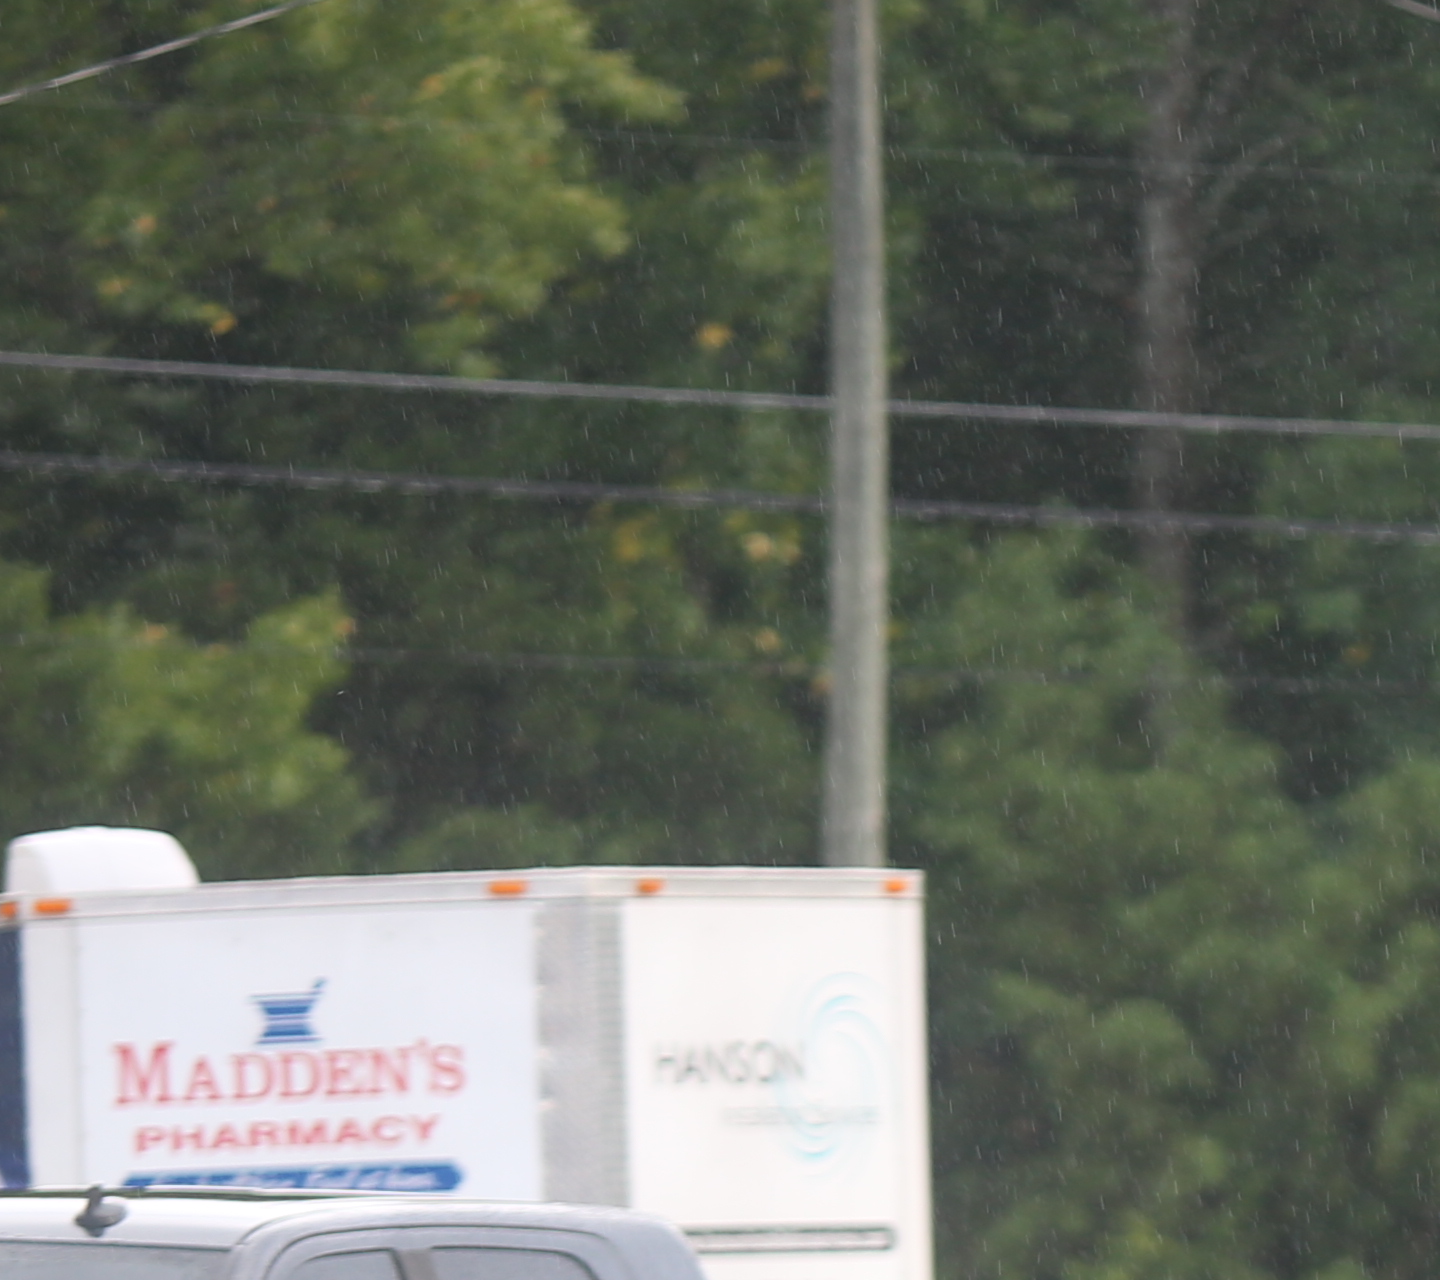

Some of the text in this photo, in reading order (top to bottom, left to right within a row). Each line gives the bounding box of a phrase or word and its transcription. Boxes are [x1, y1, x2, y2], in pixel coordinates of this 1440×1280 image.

[113, 1038, 468, 1107] MADDEN'S
[653, 1039, 808, 1086] HANSON
[134, 1114, 442, 1153] PHARMACY
